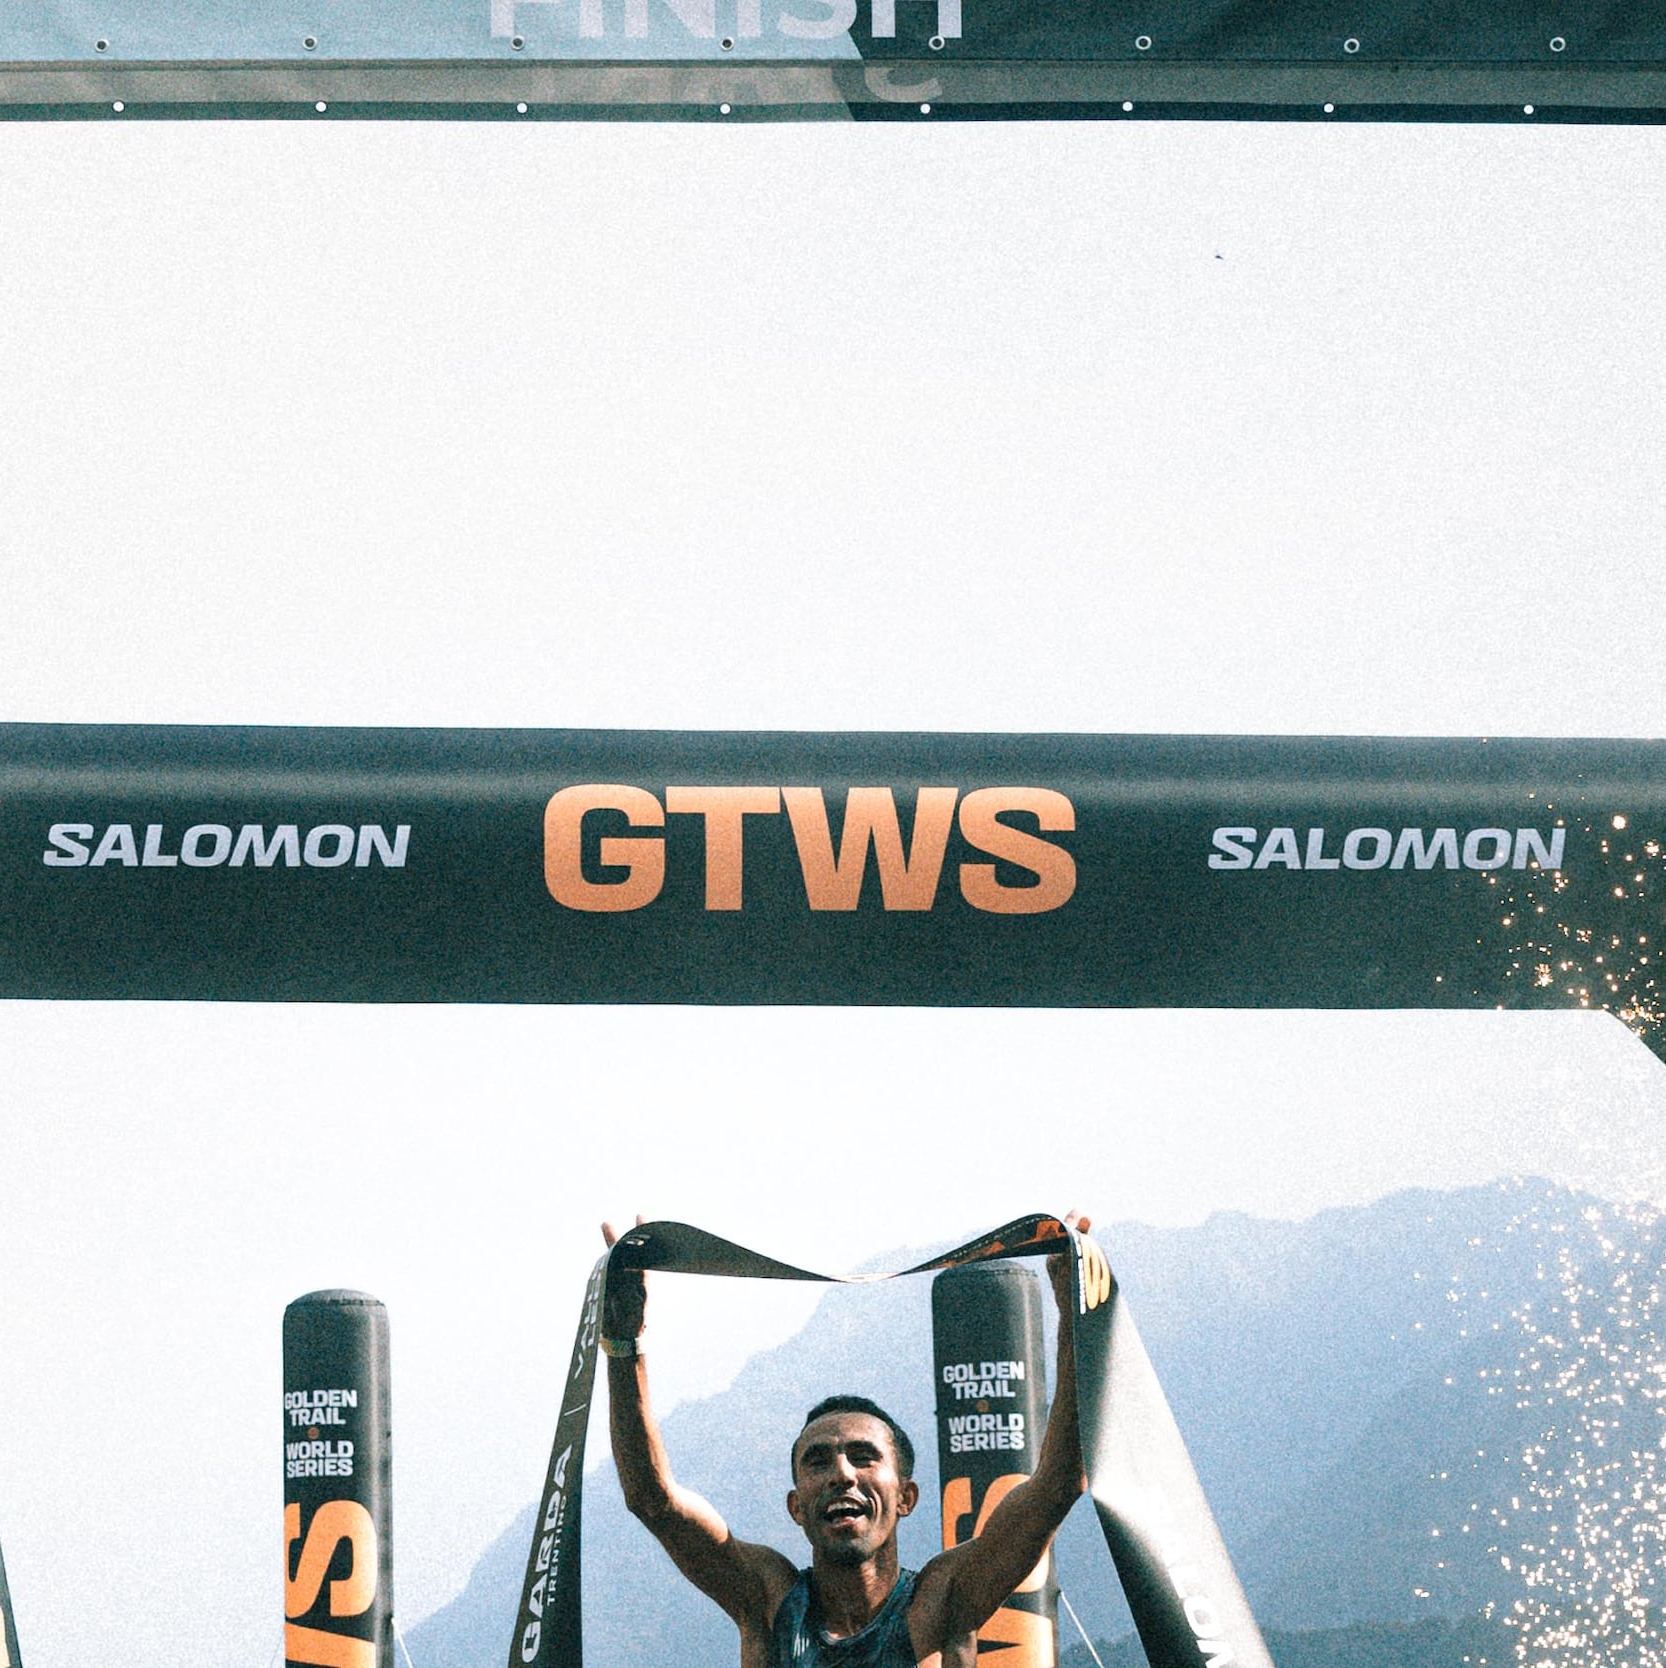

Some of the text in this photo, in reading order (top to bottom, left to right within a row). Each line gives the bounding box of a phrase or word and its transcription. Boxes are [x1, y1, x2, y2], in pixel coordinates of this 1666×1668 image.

[42, 823, 410, 869] SALOMON
[544, 785, 1077, 914] GTWS
[1206, 826, 1566, 872] SALOMON
[943, 1360, 1025, 1383] GOLDEN
[284, 1389, 357, 1410] GOLDEN
[952, 1378, 1016, 1400] TRAIL
[289, 1407, 346, 1426] TRAIL
[948, 1412, 1024, 1436] WORLD
[286, 1440, 354, 1460] WORLD
[950, 1431, 1025, 1453] SERIES
[286, 1457, 353, 1478] SERIES
[521, 1443, 572, 1663] GARDA
[547, 1495, 567, 1606] TRENTINO
